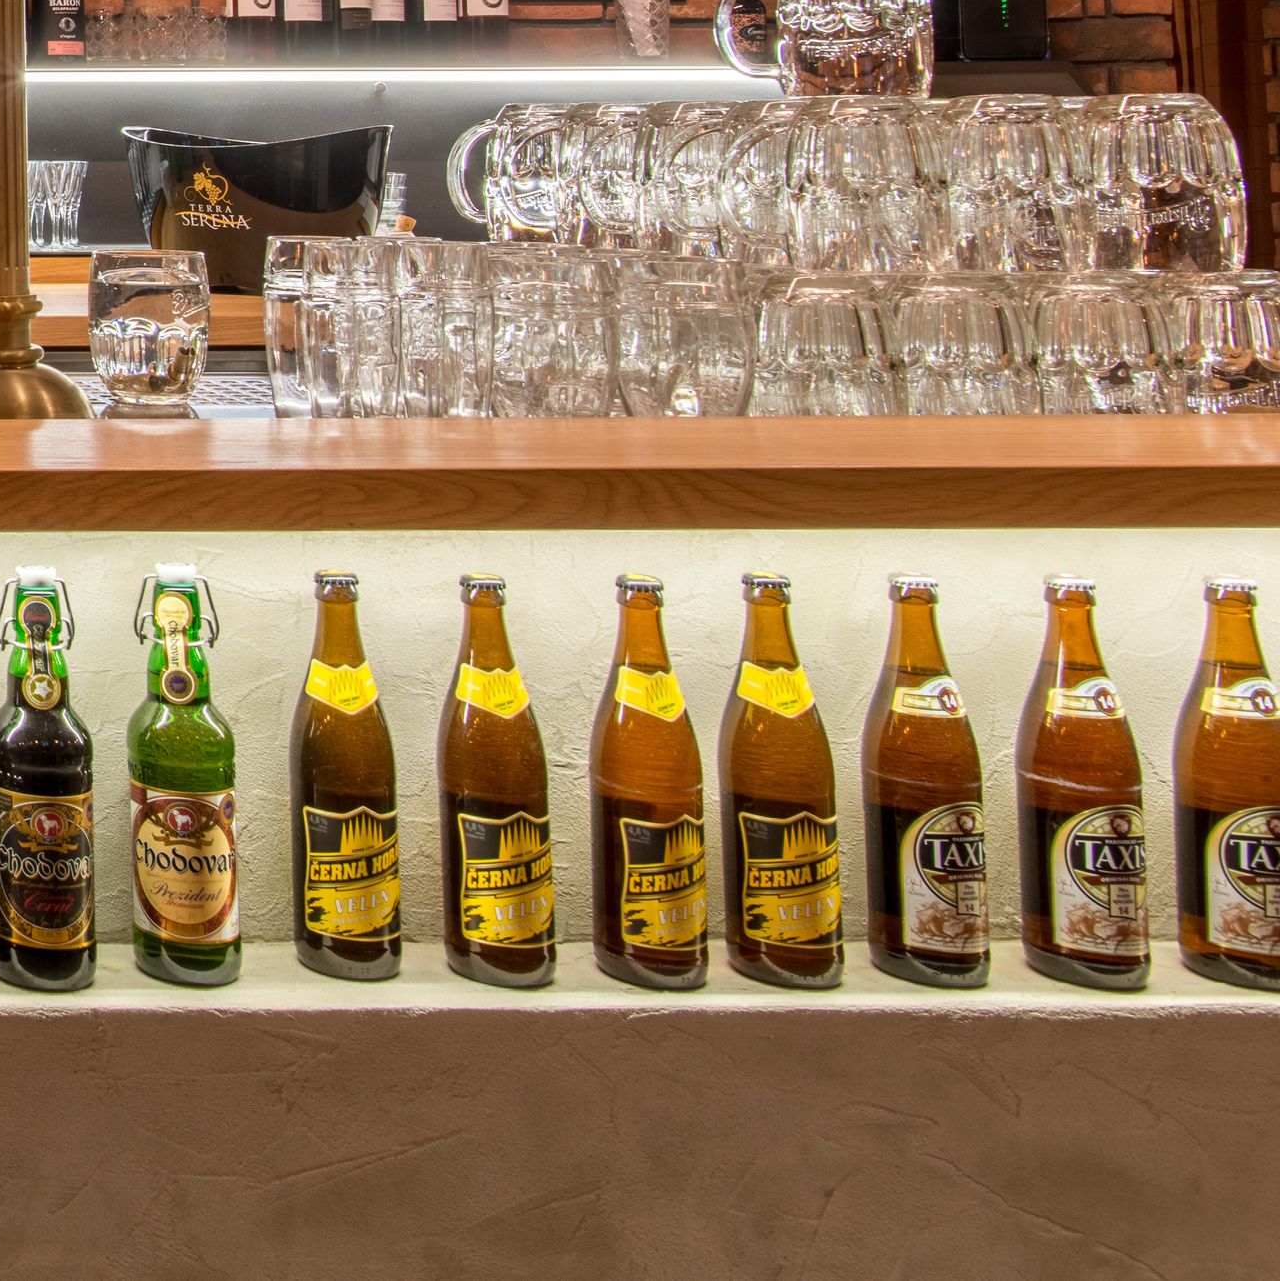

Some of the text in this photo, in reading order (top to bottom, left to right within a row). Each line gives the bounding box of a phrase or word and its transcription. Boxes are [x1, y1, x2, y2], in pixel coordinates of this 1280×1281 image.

[189, 203, 233, 213] TERRA
[181, 212, 252, 230] SERENA
[943, 694, 957, 709] 14
[1100, 694, 1115, 710] 14
[1253, 694, 1274, 711] 14
[136, 838, 234, 877] Chodovar
[310, 860, 369, 882] ČERNÁ
[467, 865, 528, 889] ČERNÁ
[749, 866, 812, 889] ČERNÁ
[150, 880, 222, 902] Prezident
[629, 870, 690, 894] ČERNÁ
[964, 903, 975, 914] 14
[1117, 904, 1130, 915] 14
